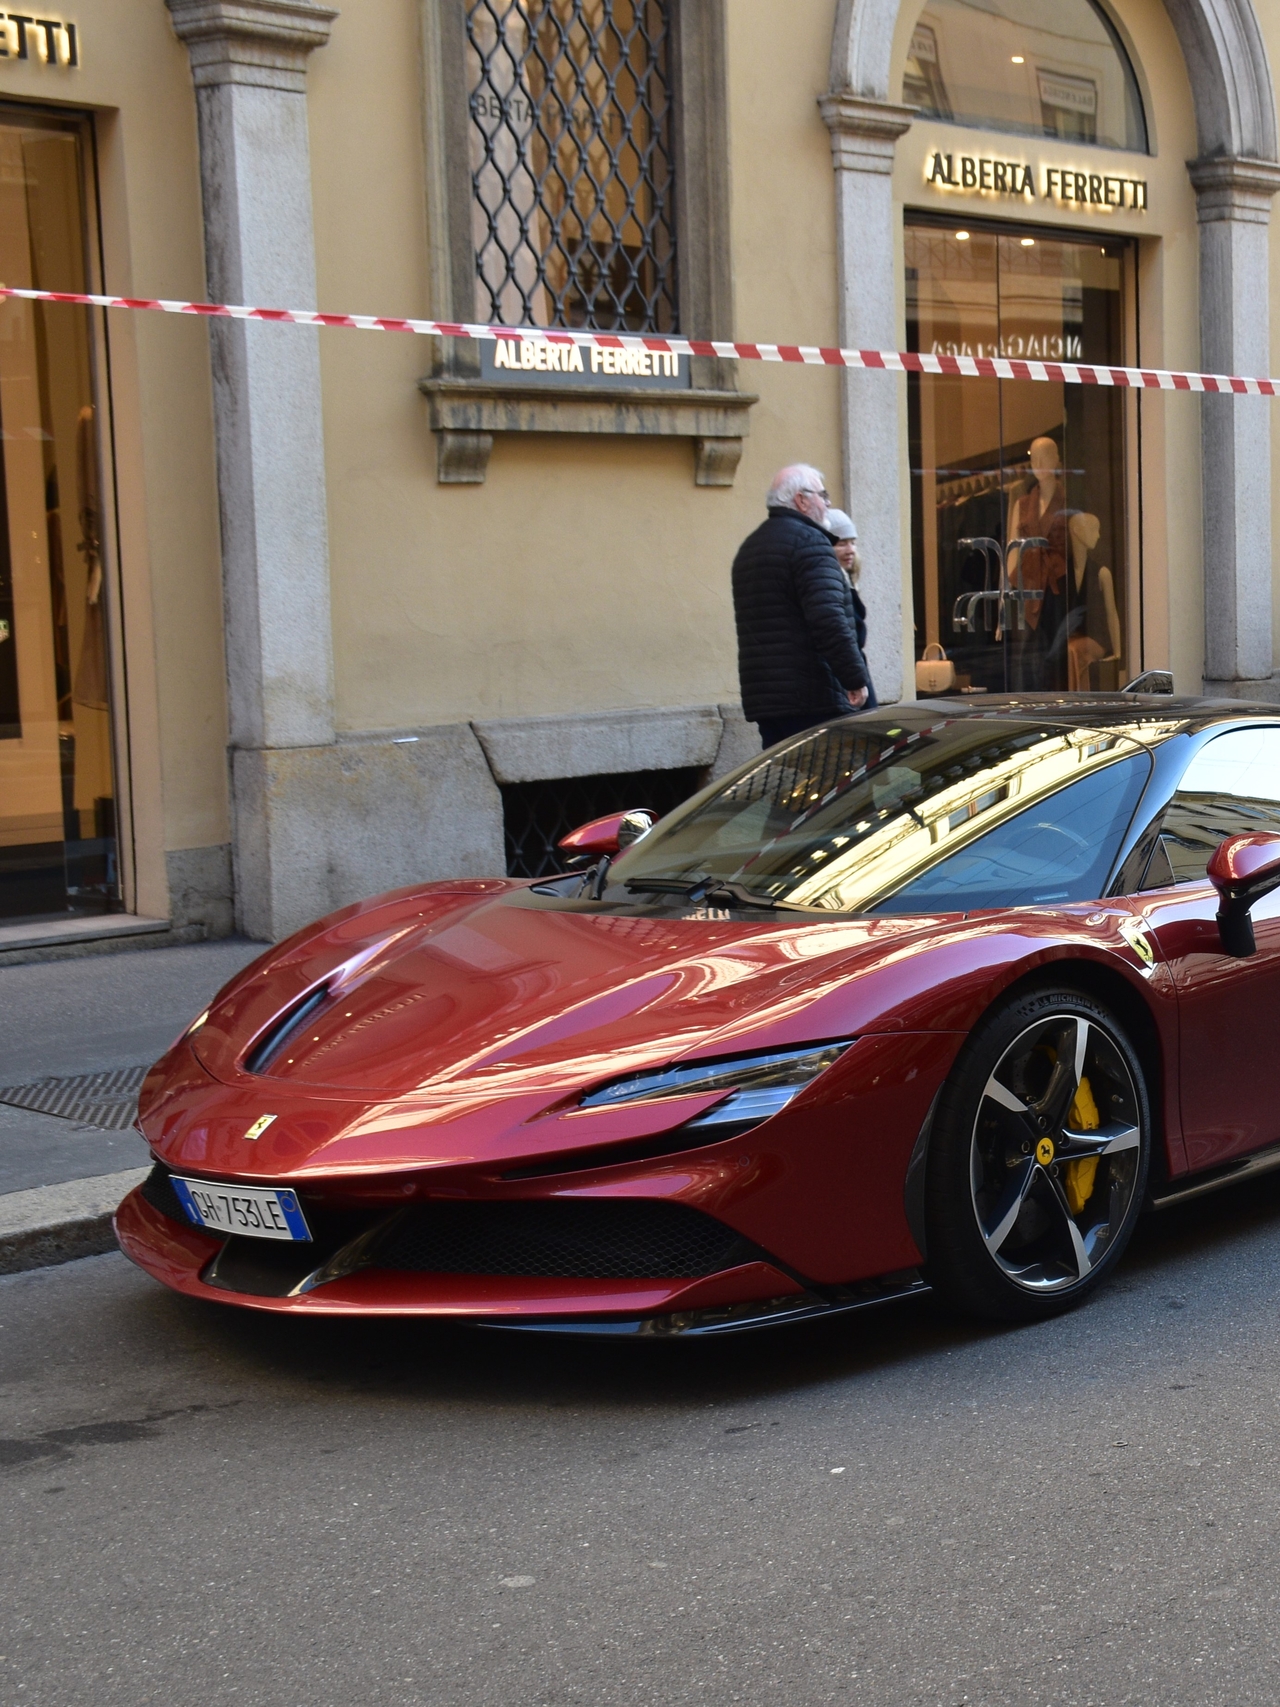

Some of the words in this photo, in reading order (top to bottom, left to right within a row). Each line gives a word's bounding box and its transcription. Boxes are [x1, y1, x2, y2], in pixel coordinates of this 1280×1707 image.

[928, 152, 1035, 196] ALBERTA
[1045, 168, 1148, 210] FERRETTI
[494, 338, 585, 373] ALBERTA
[590, 344, 679, 377] FERRETTI
